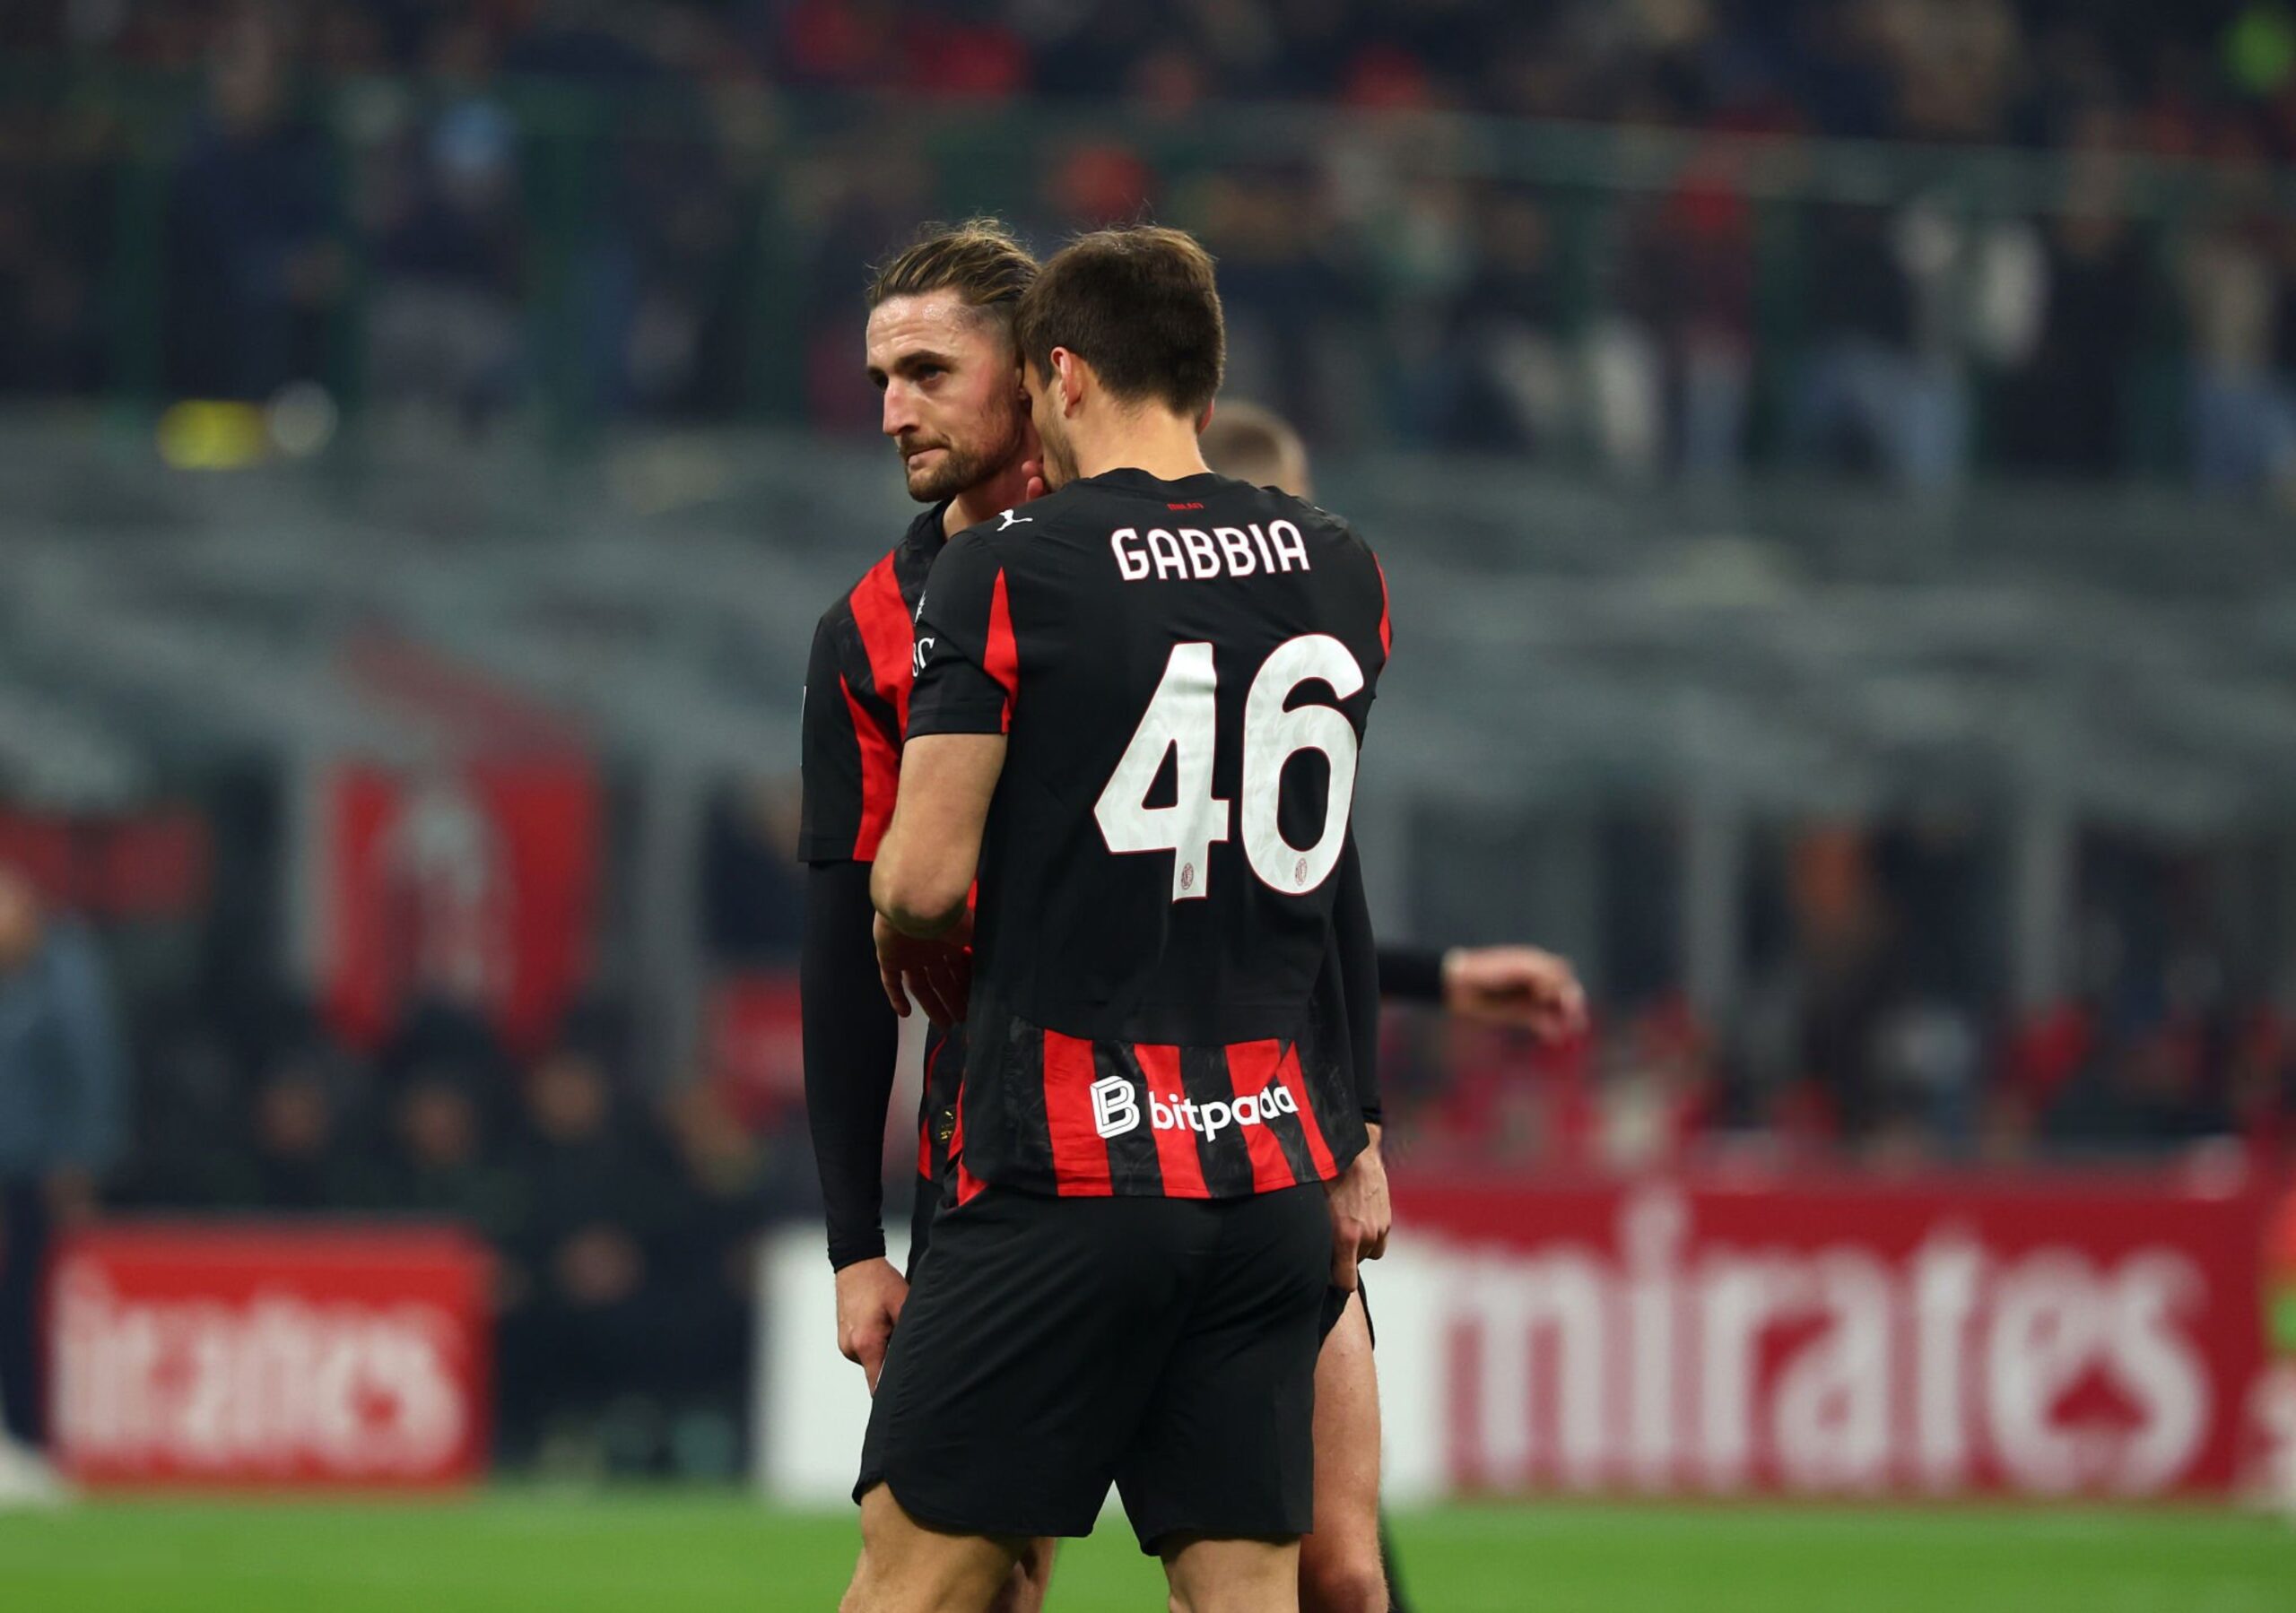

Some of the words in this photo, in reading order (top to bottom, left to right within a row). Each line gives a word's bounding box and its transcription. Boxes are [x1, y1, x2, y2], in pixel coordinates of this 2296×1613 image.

[1111, 519, 1310, 581] GABBIA
[1093, 633, 1364, 903] 46
[1148, 1085, 1300, 1143] bitpada
